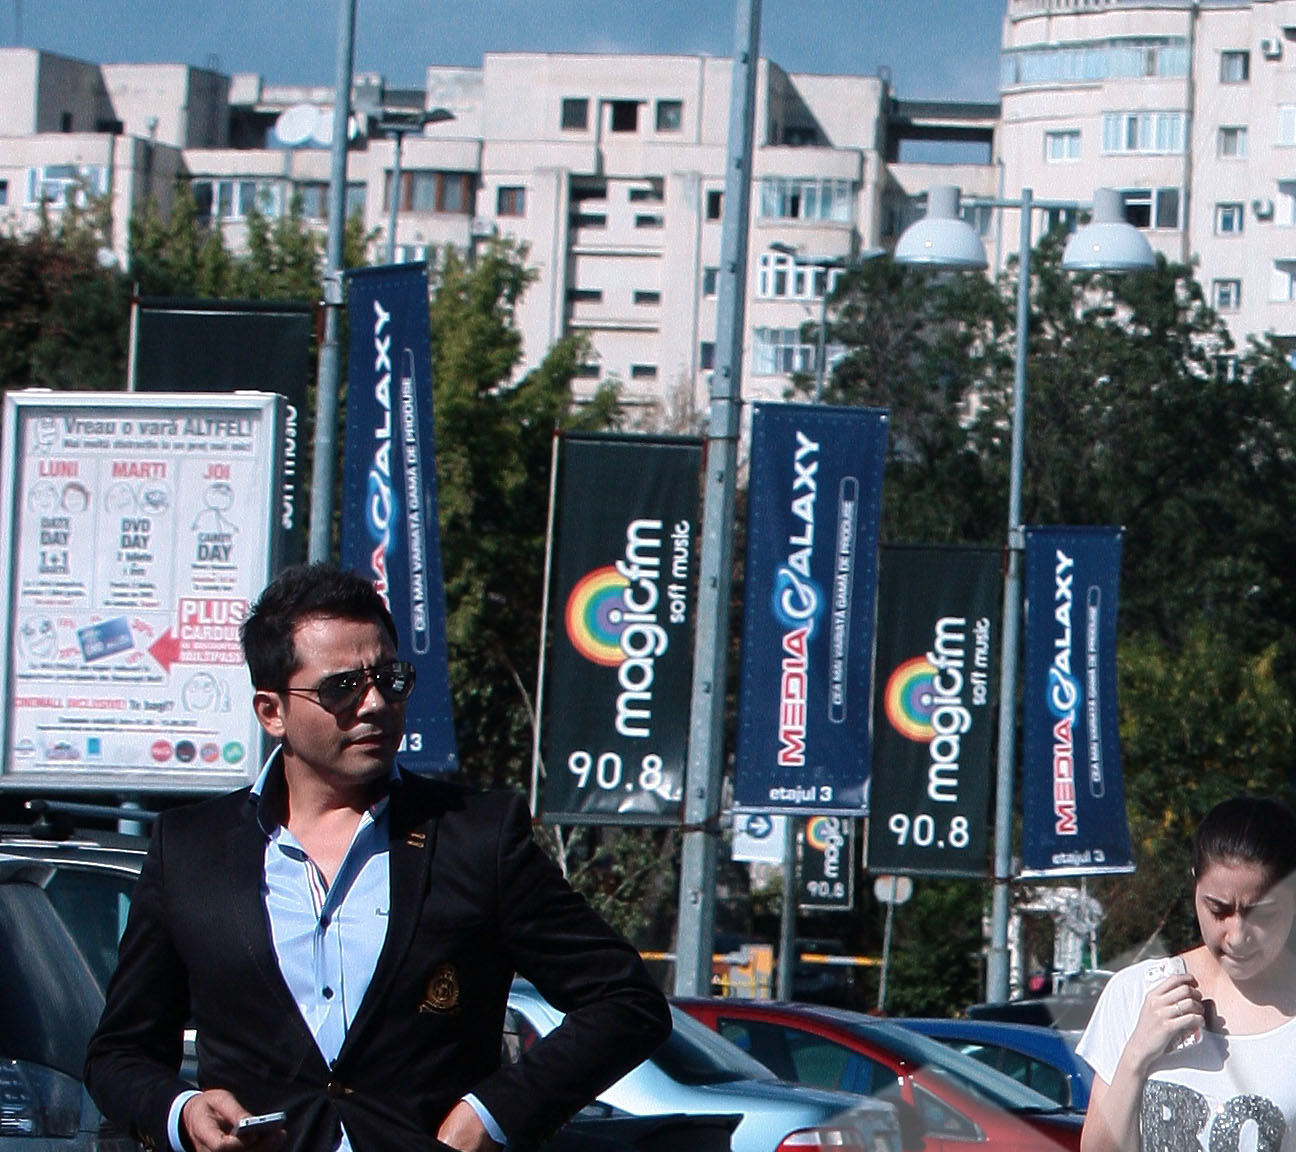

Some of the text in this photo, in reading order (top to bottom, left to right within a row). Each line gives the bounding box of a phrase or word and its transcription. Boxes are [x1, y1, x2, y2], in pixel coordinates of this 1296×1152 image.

[64, 418, 115, 434] Vreau
[122, 422, 134, 434] o
[369, 299, 391, 530] GALAXY
[39, 460, 79, 477] LUNI
[203, 463, 231, 480] JOI
[121, 535, 150, 549] DAY
[196, 545, 232, 561] DAY
[669, 519, 690, 624] soft music
[182, 601, 244, 624] PLUS
[778, 430, 820, 766] MEDIA GALAXY
[972, 617, 990, 706] soft music
[1050, 549, 1078, 836] MEDIA GALAXY
[567, 750, 663, 790] 90.8
[769, 786, 832, 803] etajul 3
[888, 814, 970, 849] 90.8
